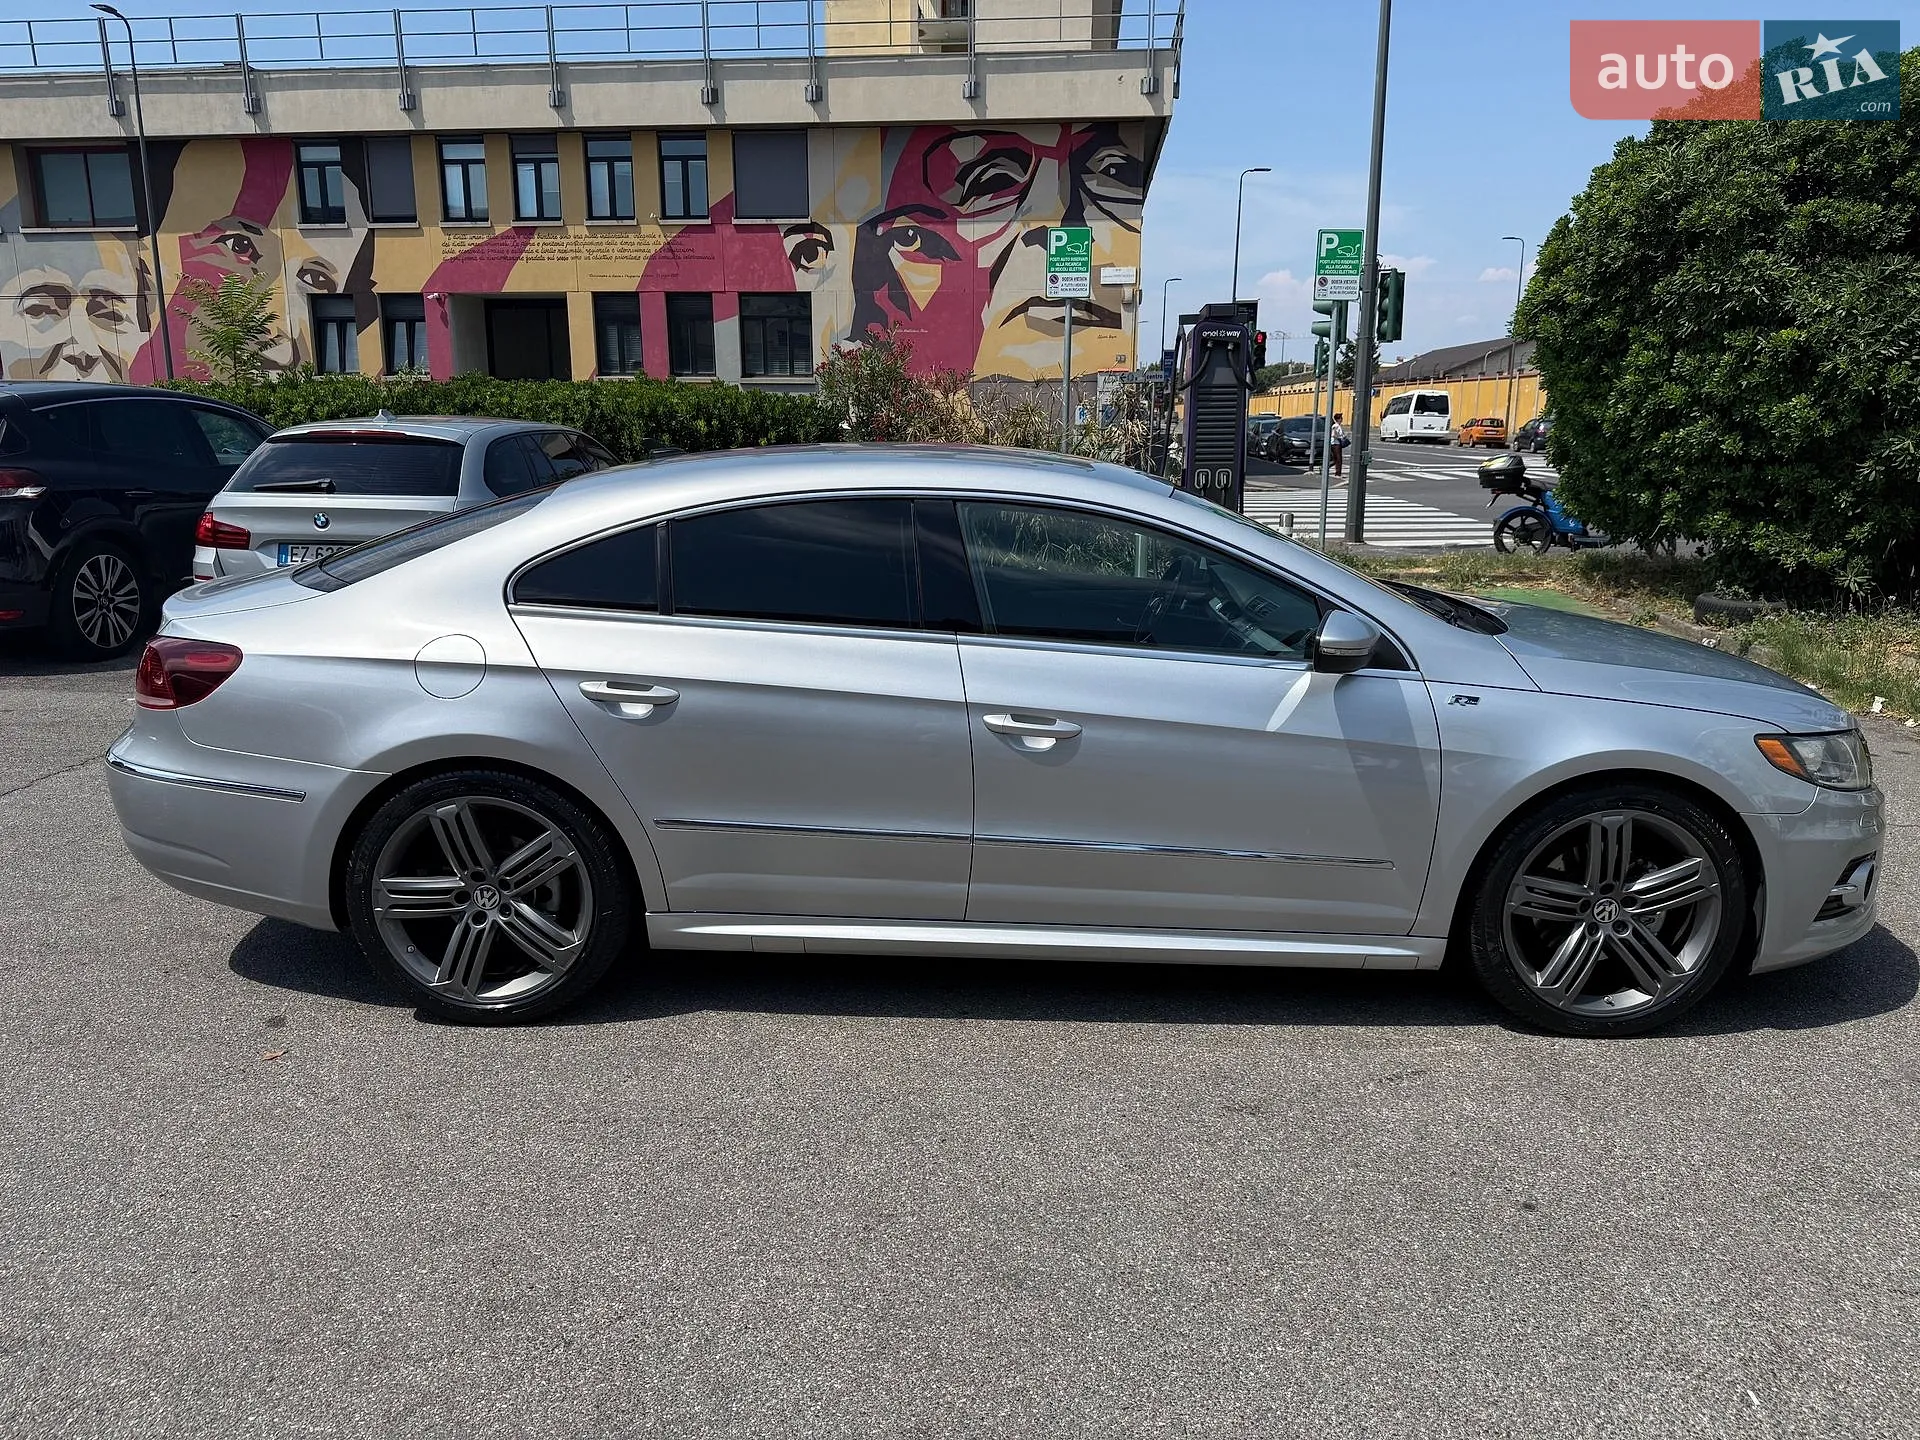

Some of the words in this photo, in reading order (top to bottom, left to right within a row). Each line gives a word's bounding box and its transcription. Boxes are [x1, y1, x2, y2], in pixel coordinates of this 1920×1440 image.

[1050, 230, 1068, 255] P
[1320, 233, 1339, 257] P
[1226, 330, 1241, 338] way
[290, 546, 309, 563] EZ
